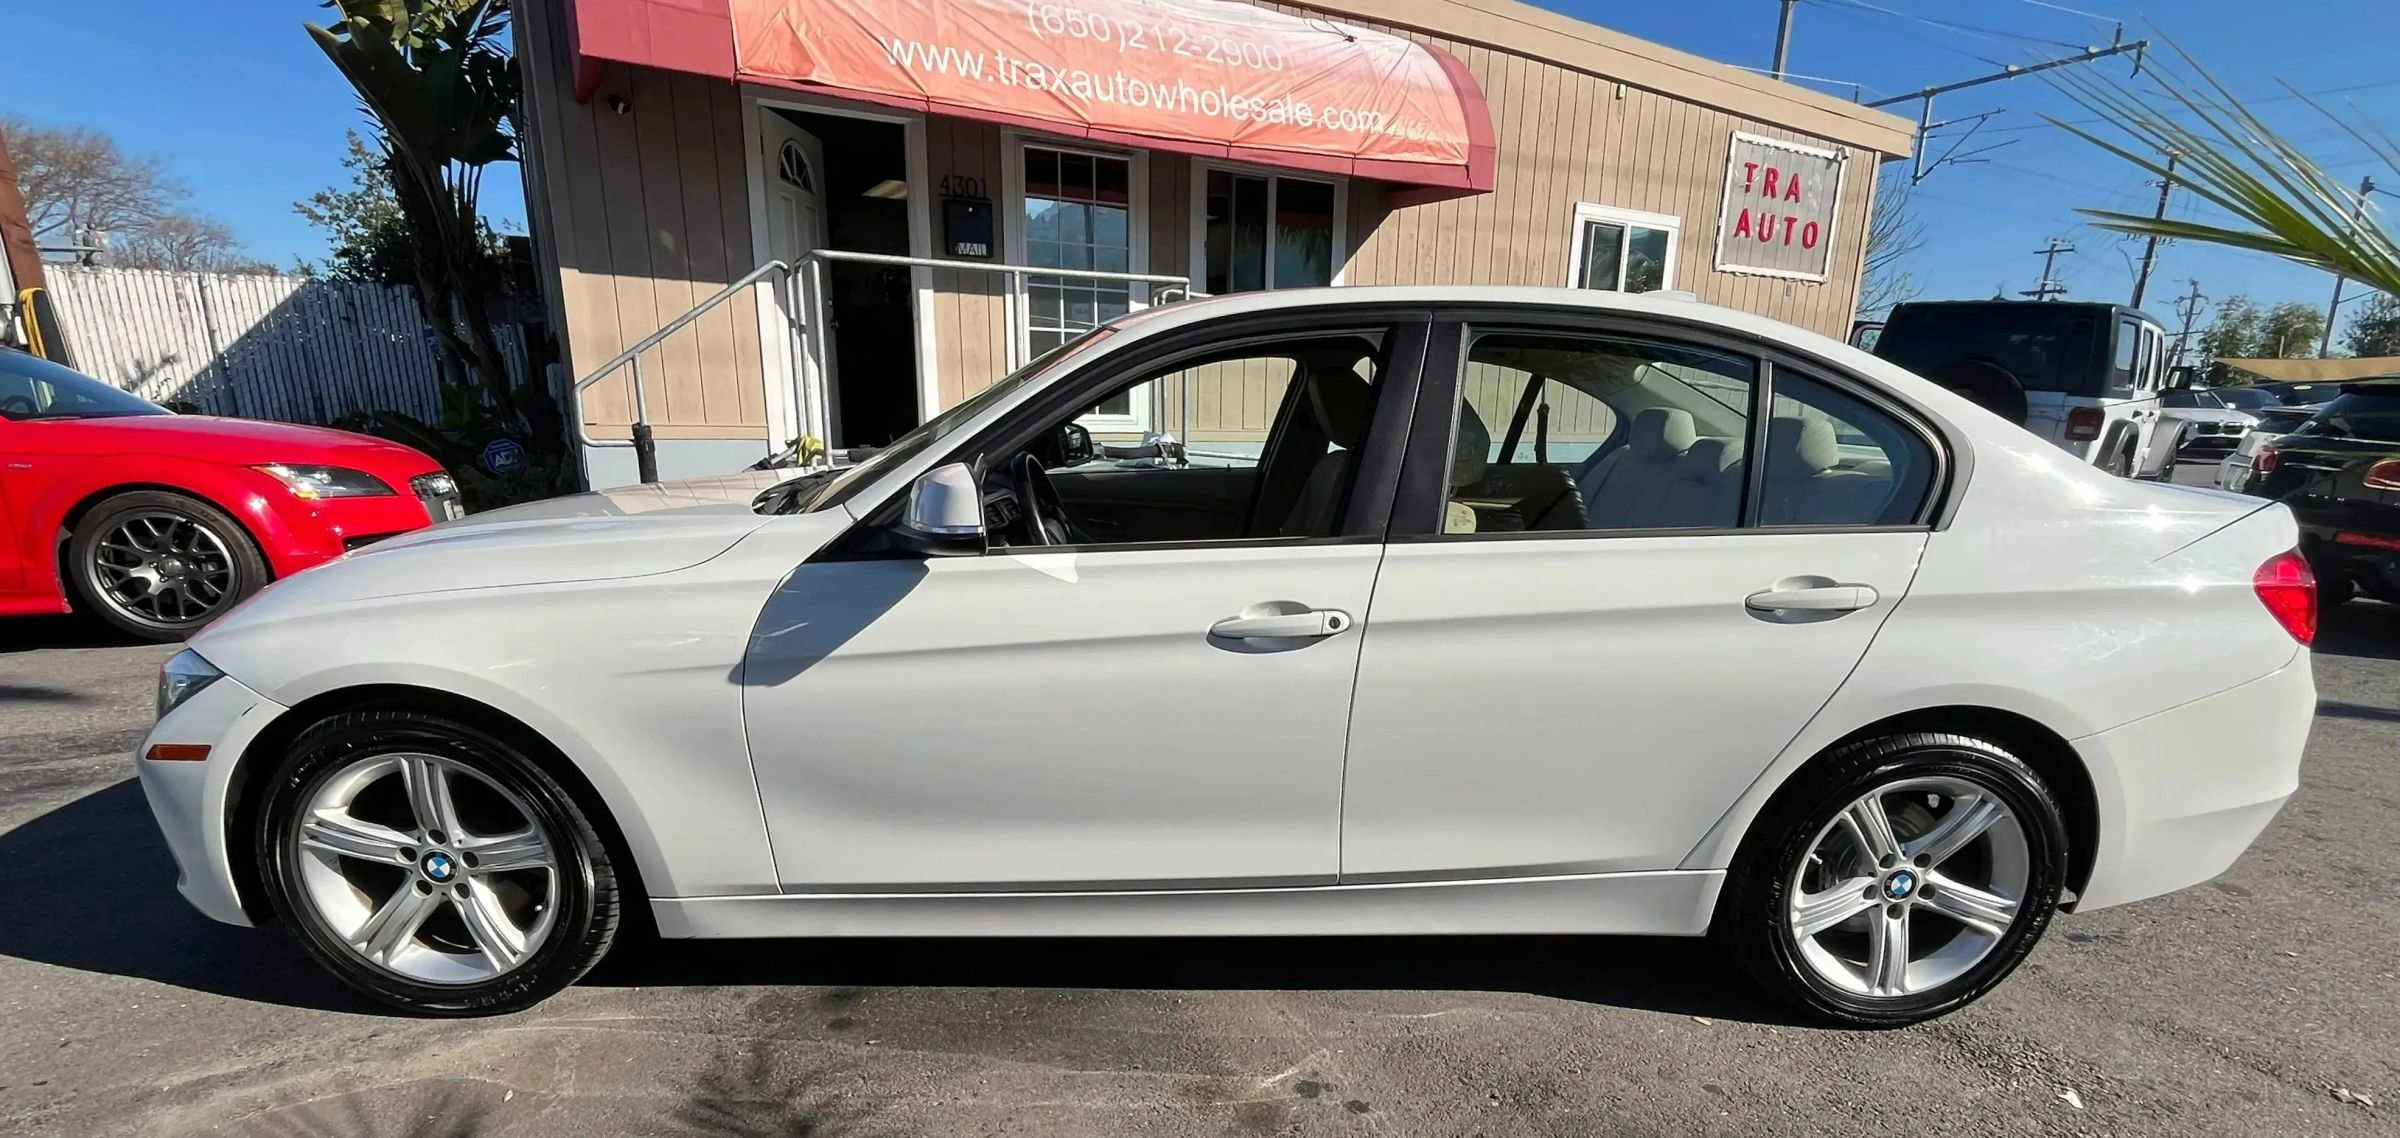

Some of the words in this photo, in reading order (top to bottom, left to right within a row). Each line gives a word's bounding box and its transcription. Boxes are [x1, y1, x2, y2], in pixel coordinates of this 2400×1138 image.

[1026, 1, 1284, 71] (650)212-2900
[879, 36, 1384, 133] www.traxautowholesale.com
[938, 174, 987, 199] 4301
[1744, 161, 1801, 204] TRA
[955, 242, 987, 256] MAIL
[1734, 208, 1819, 250] AUTO
